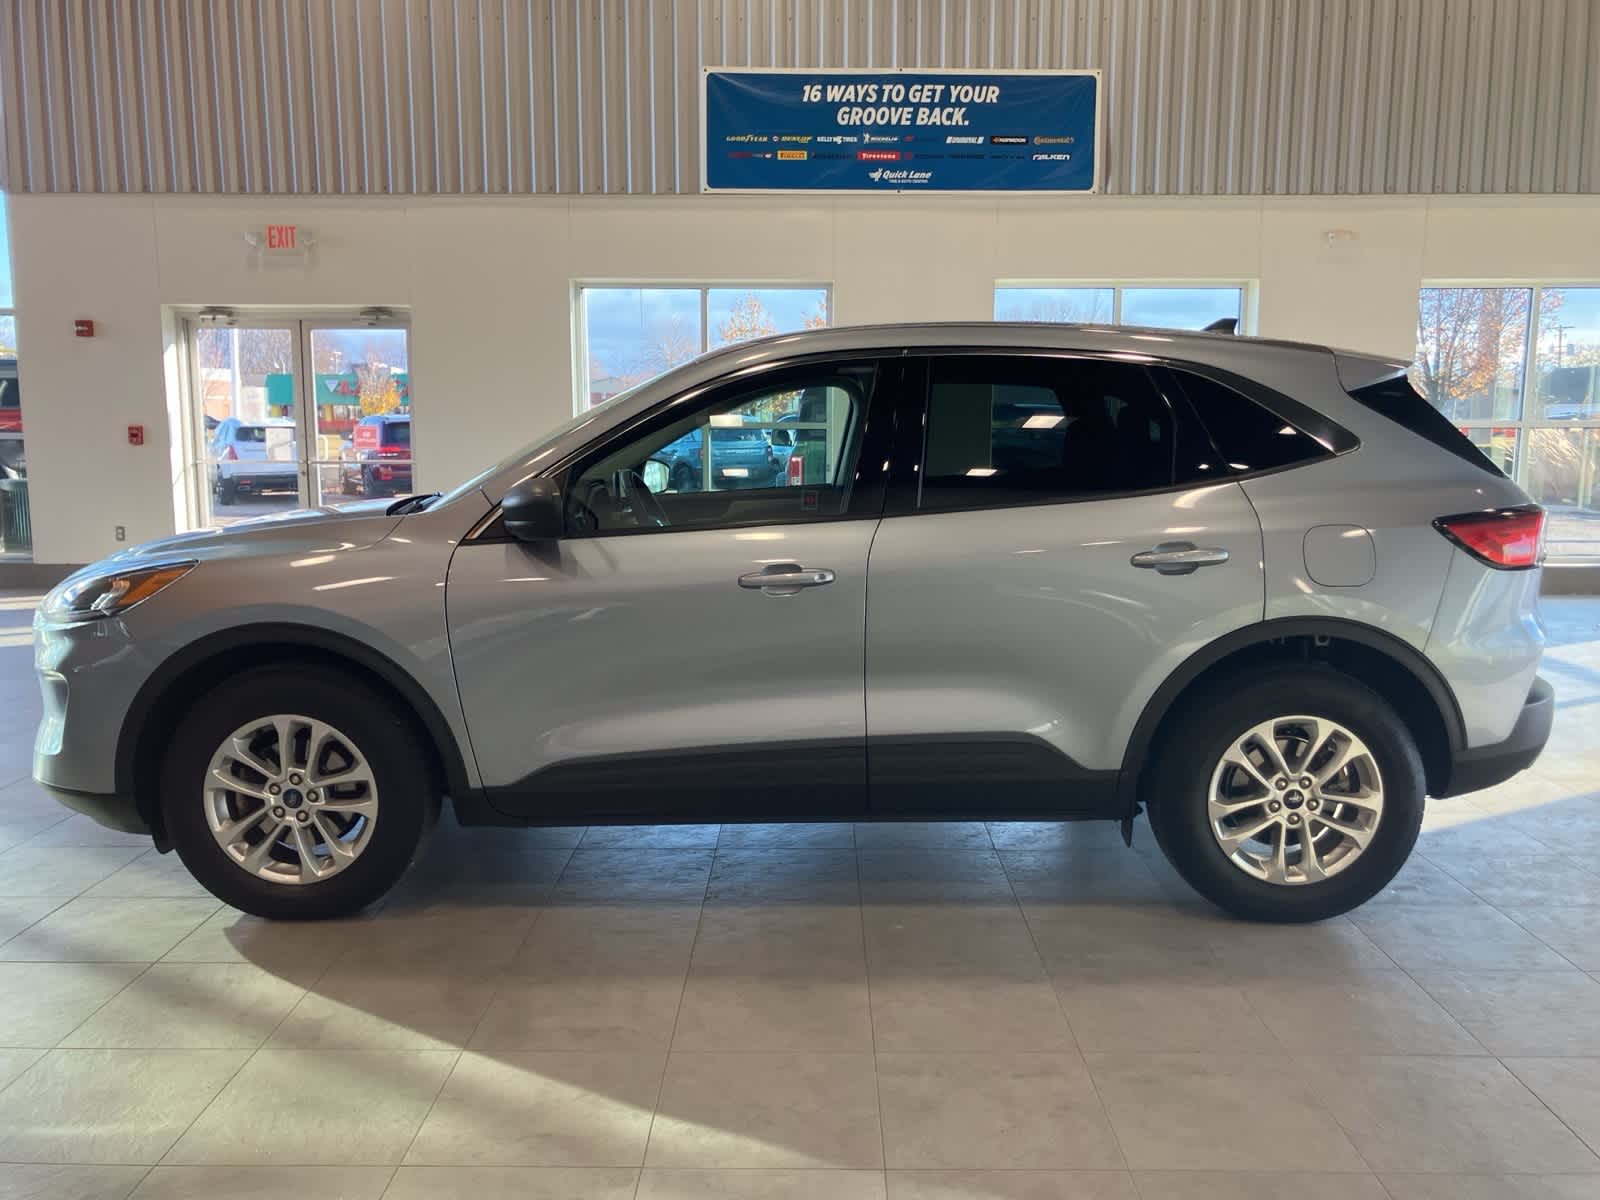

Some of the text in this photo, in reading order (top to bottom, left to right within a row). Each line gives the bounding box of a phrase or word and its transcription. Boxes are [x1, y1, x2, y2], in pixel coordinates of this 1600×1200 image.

[803, 85, 1000, 103] 16 WAYS TO GET YOUR
[837, 107, 969, 126] GROOVE BACK.
[883, 170, 932, 179] Quick Lane
[268, 225, 296, 249] EXIT
